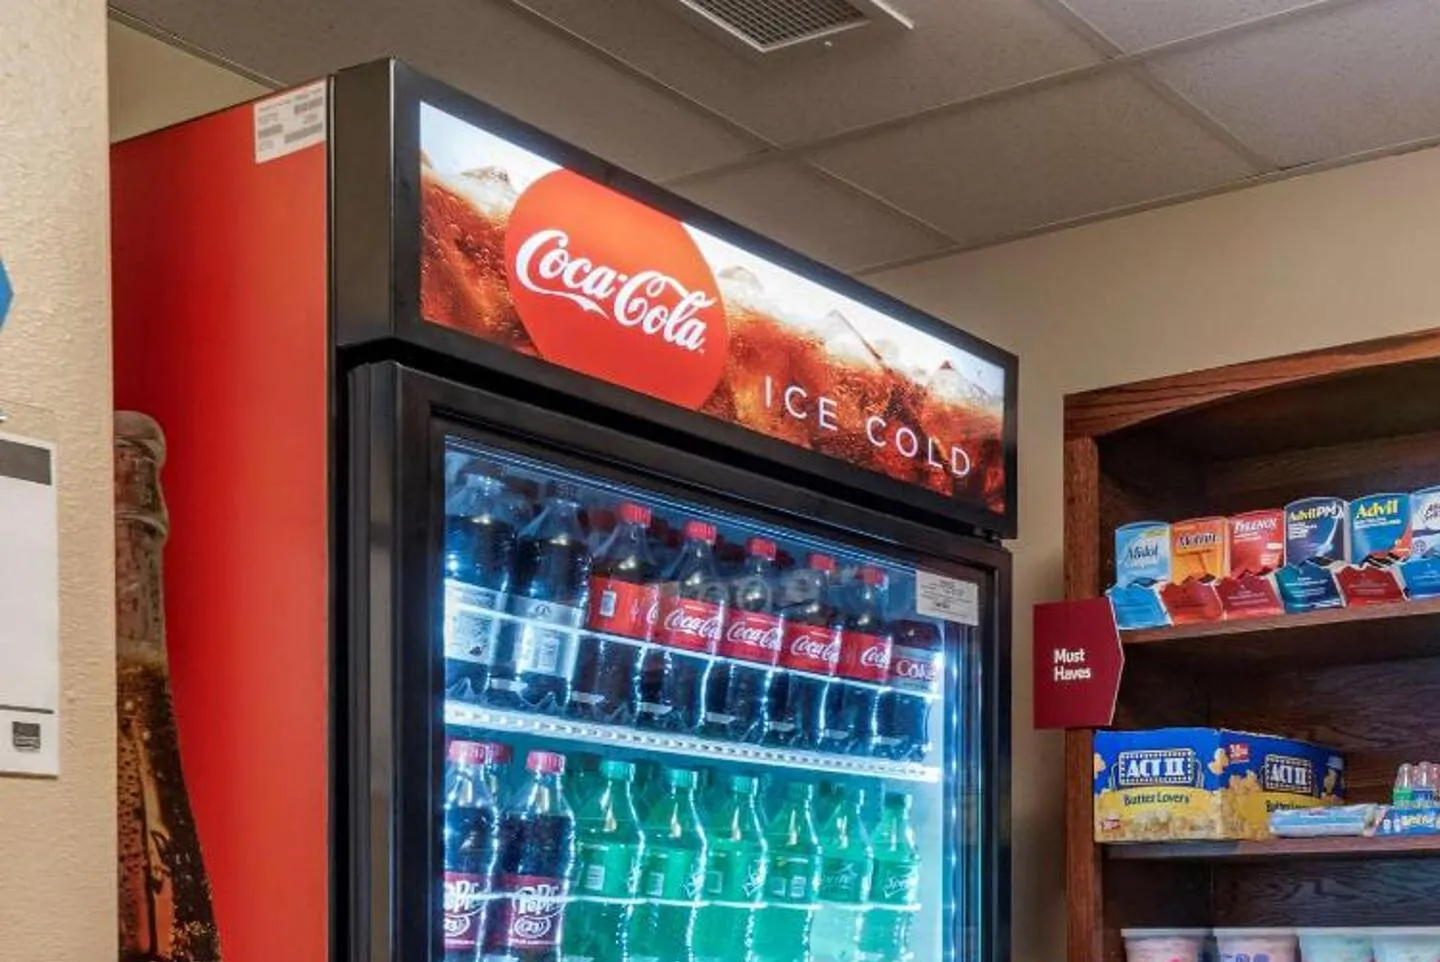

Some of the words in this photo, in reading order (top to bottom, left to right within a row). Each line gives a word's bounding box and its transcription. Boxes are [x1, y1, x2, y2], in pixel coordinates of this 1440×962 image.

[516, 229, 716, 353] Coca-Cola
[766, 377, 838, 432] ICE
[867, 418, 970, 478] COLD
[1356, 500, 1398, 518] Advil
[1054, 649, 1086, 663] Must
[1054, 666, 1091, 681] Haves
[1127, 760, 1160, 776] ACT
[1124, 794, 1155, 806] Butter
